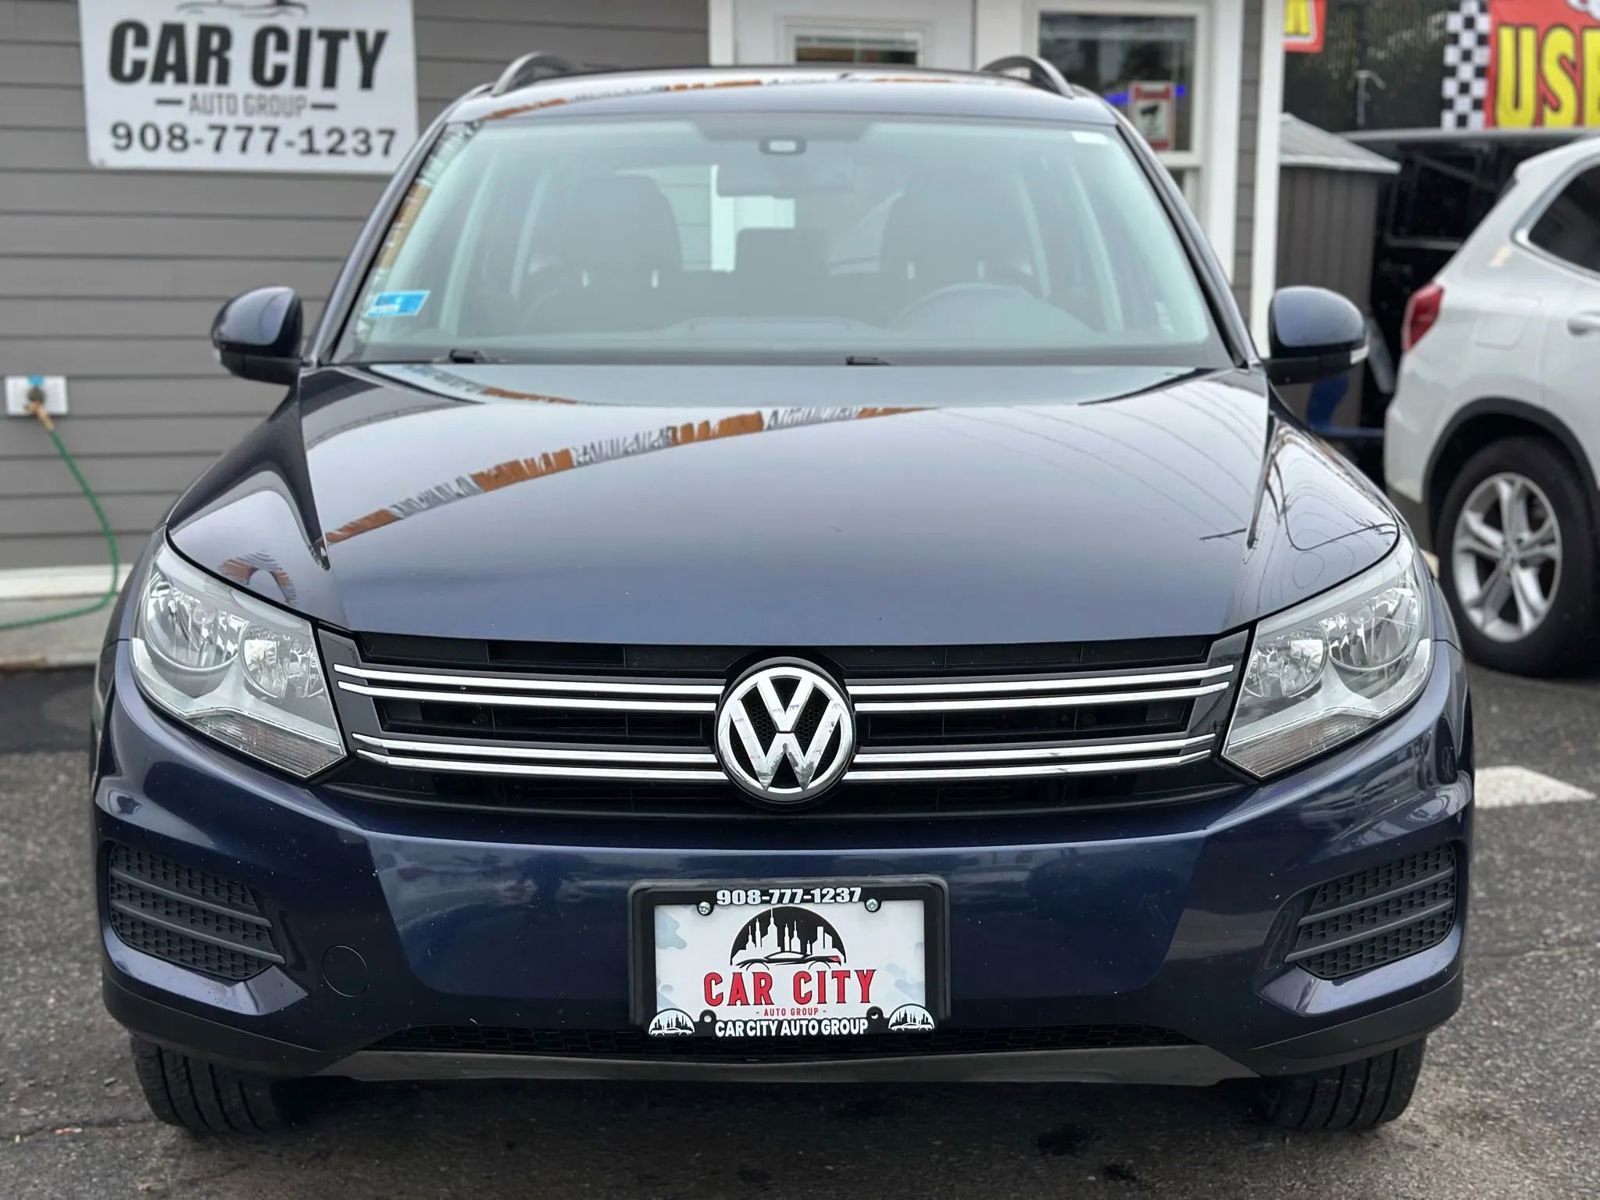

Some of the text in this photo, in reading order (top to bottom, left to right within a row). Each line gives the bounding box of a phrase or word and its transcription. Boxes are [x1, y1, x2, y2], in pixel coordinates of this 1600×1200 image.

[107, 20, 389, 91] CAR CITY
[189, 93, 307, 118] AUTO GROUP
[110, 122, 397, 157] 908-777-1237
[716, 887, 862, 905] 908-777-1237
[703, 968, 877, 1007] CAR CITY
[763, 1007, 819, 1017] AUTO GROUP
[715, 1018, 868, 1037] CAR CITY AUTO GROUP
